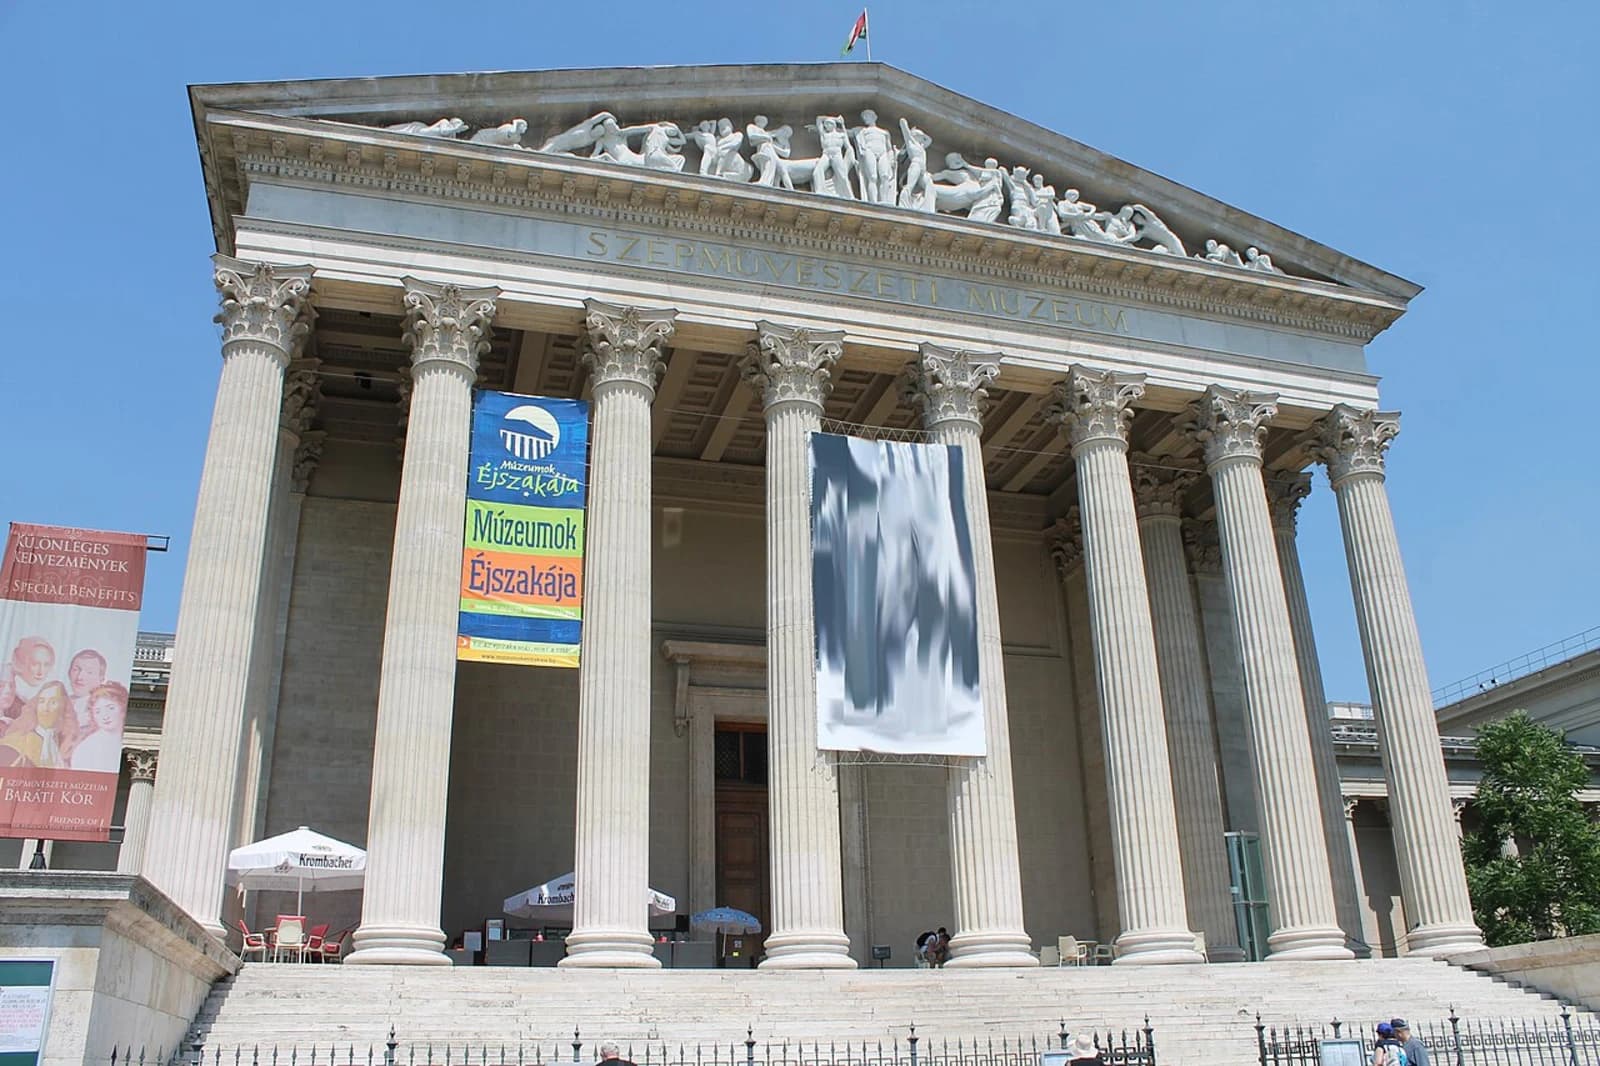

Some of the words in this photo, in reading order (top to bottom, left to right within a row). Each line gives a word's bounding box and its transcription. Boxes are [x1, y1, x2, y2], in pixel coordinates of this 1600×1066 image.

[500, 460, 556, 474] Múzeumok
[473, 509, 577, 550] Múzeumok
[468, 552, 577, 601] Éjszakája
[69, 584, 138, 602] BENEFITS
[299, 853, 353, 869] Krombacher
